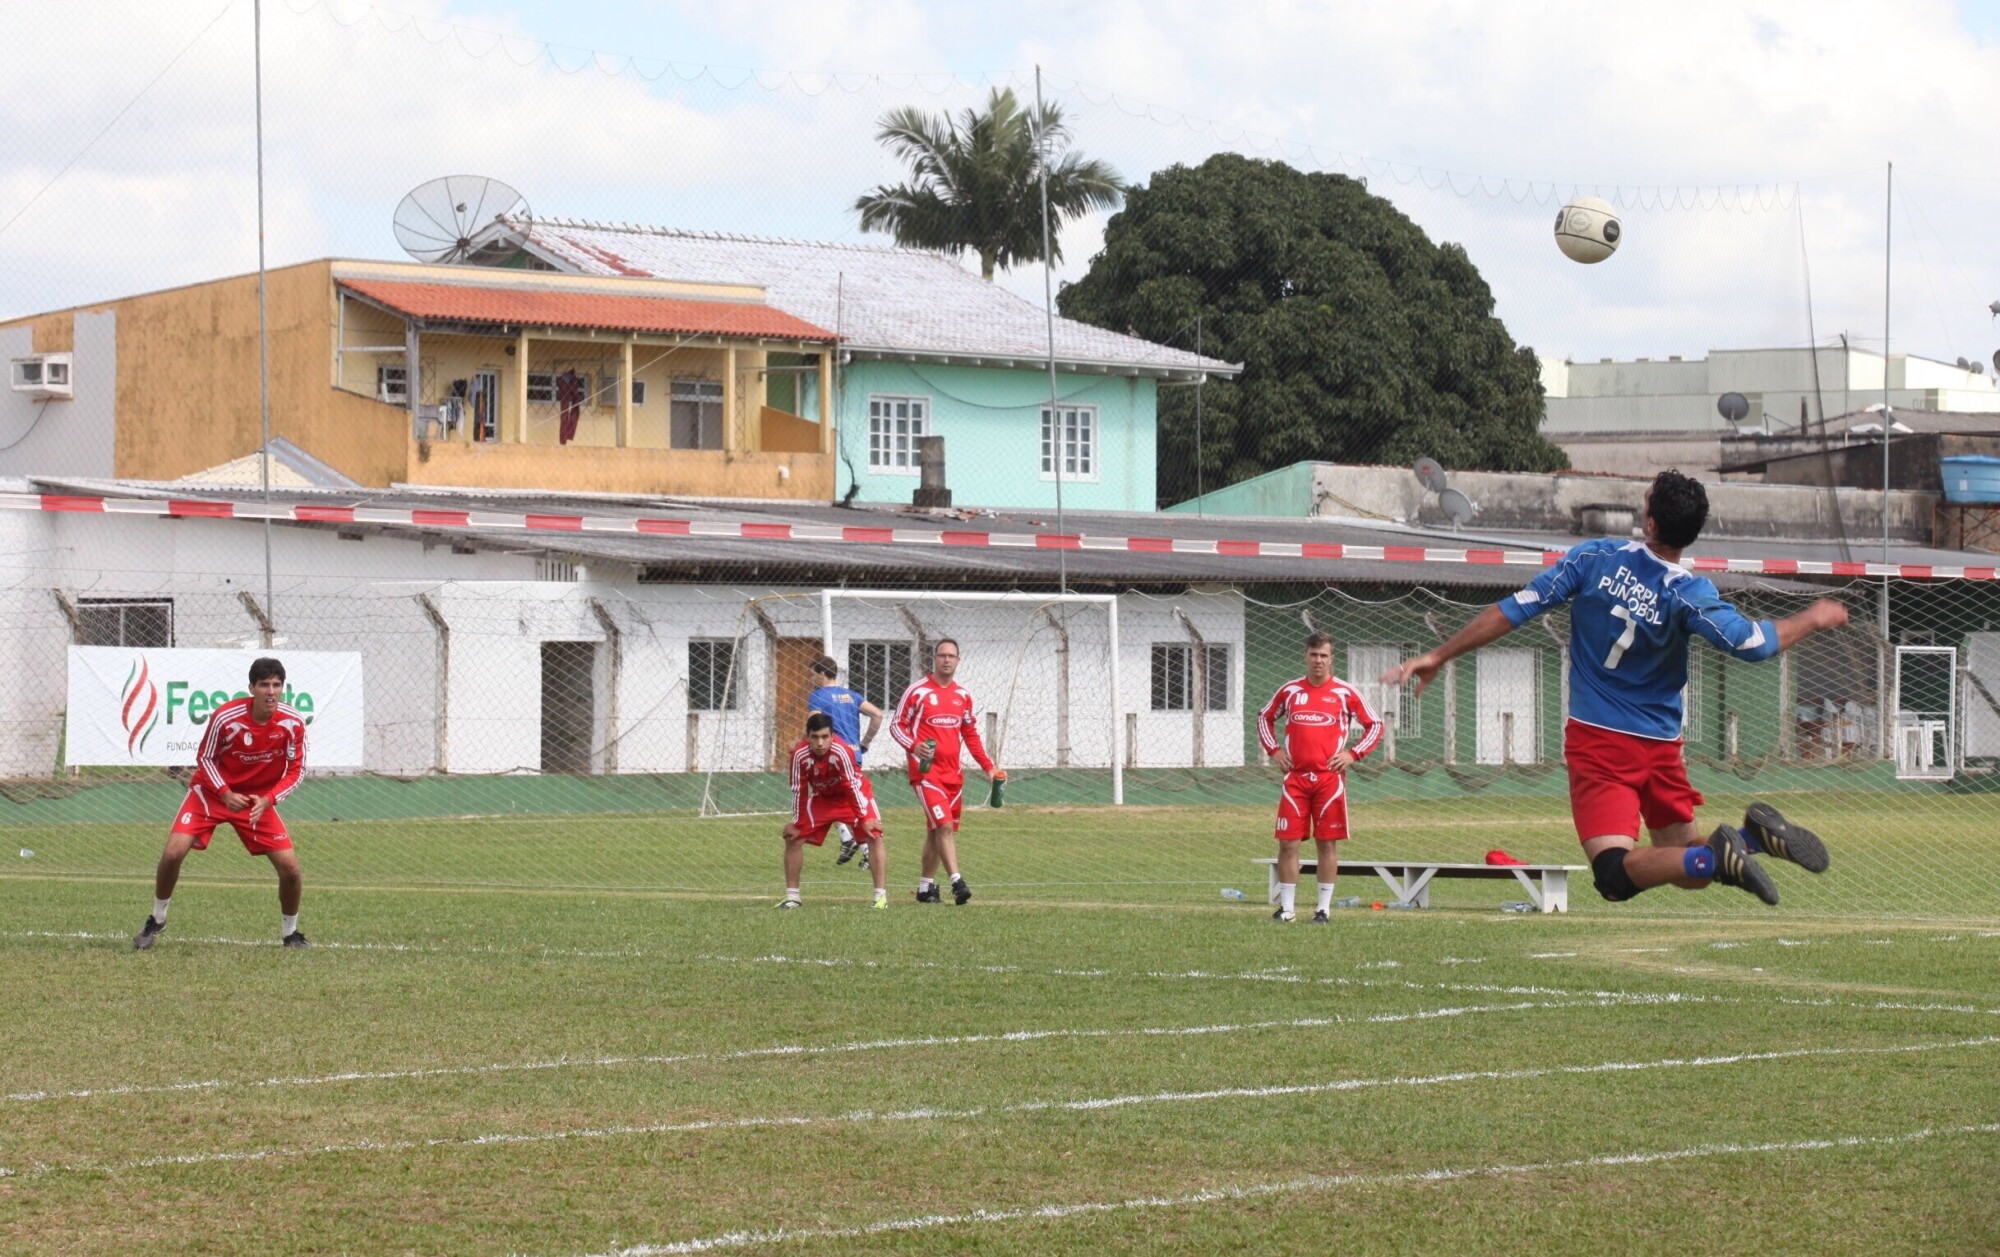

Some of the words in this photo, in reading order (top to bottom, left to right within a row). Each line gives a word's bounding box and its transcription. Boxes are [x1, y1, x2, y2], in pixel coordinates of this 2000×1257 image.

[1603, 604, 1637, 669] 7
[929, 693, 938, 706] 8
[1295, 693, 1308, 705] 10
[931, 716, 957, 724] condor
[1294, 713, 1325, 722] condor
[243, 731, 253, 746] 6
[181, 811, 192, 825] 6
[1276, 816, 1288, 831] 10
